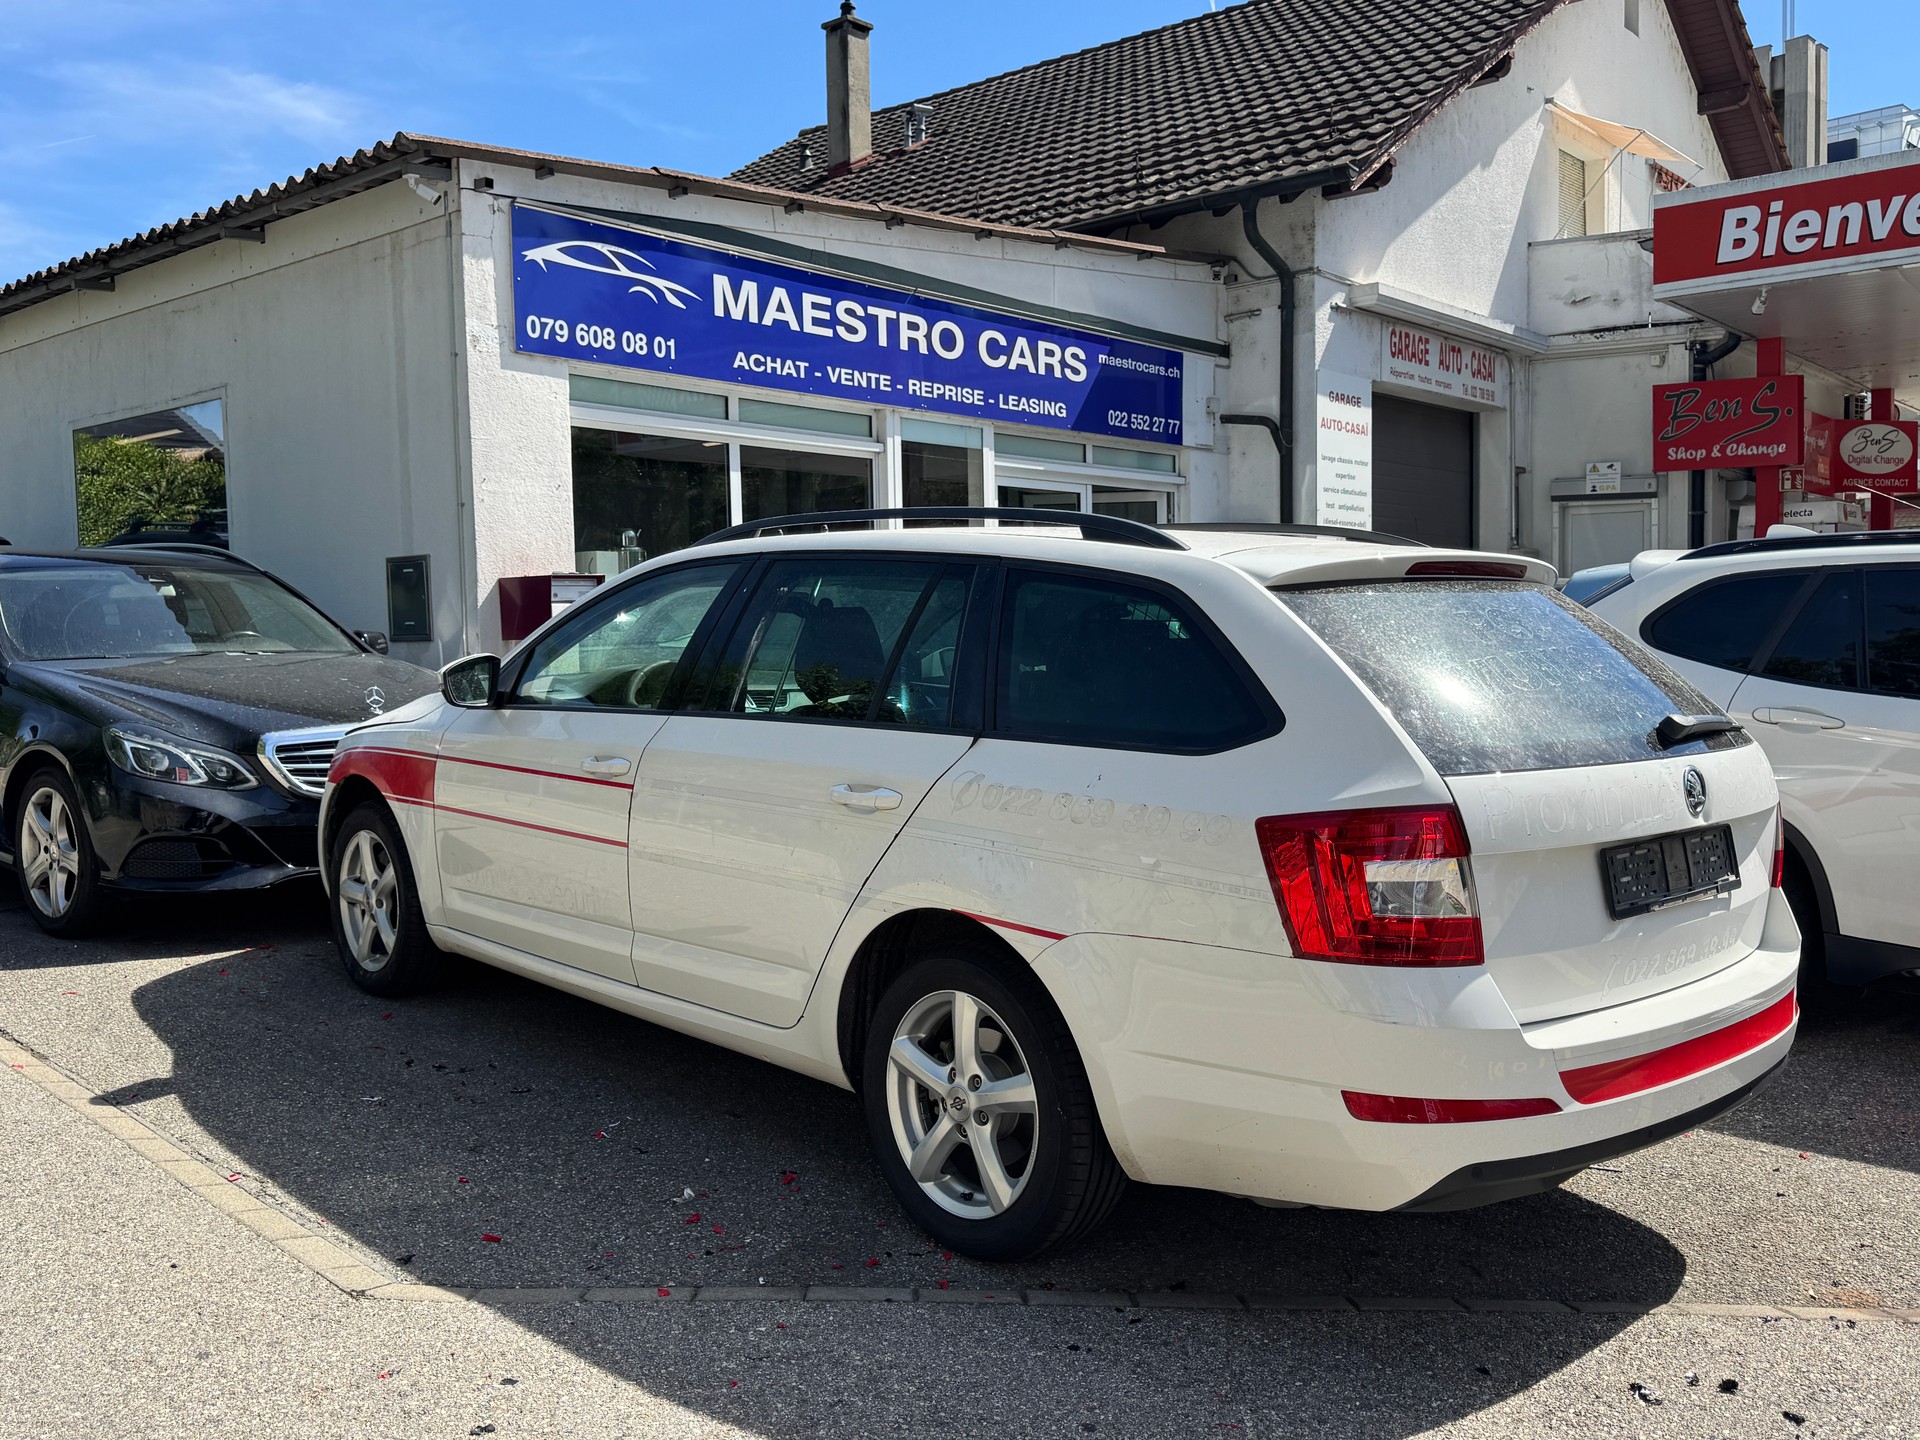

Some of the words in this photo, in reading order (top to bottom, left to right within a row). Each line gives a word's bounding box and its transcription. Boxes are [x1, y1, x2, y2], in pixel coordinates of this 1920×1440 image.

[526, 315, 569, 343] 079
[575, 323, 616, 351] 608
[622, 331, 648, 356] 08
[653, 336, 676, 360] 01
[712, 273, 965, 360] MAESTRO
[978, 330, 1088, 382] CARS
[1390, 328, 1430, 367] GARAGE
[1438, 342, 1462, 375] AUTO
[1098, 353, 1181, 379] maestrocars.ch
[733, 351, 809, 379] ACHAT
[826, 366, 892, 391] VENTE
[908, 379, 985, 406] REPRISE
[999, 393, 1067, 418] LEASING
[1328, 390, 1362, 408] GARAGE
[1108, 410, 1128, 428] 022
[1131, 413, 1150, 431] 552
[1152, 418, 1165, 433] 27
[1167, 419, 1180, 435] 77
[1658, 388, 1742, 442] Ben
[1667, 446, 1707, 461] Shop
[1711, 444, 1722, 458] &
[1726, 442, 1787, 457] Change
[1847, 454, 1873, 467] Digital
[1323, 486, 1339, 494] service
[1842, 478, 1874, 487] AGENCE
[1875, 478, 1910, 487] CONTACT
[1783, 509, 1813, 518] electa
[981, 783, 1043, 817] 022
